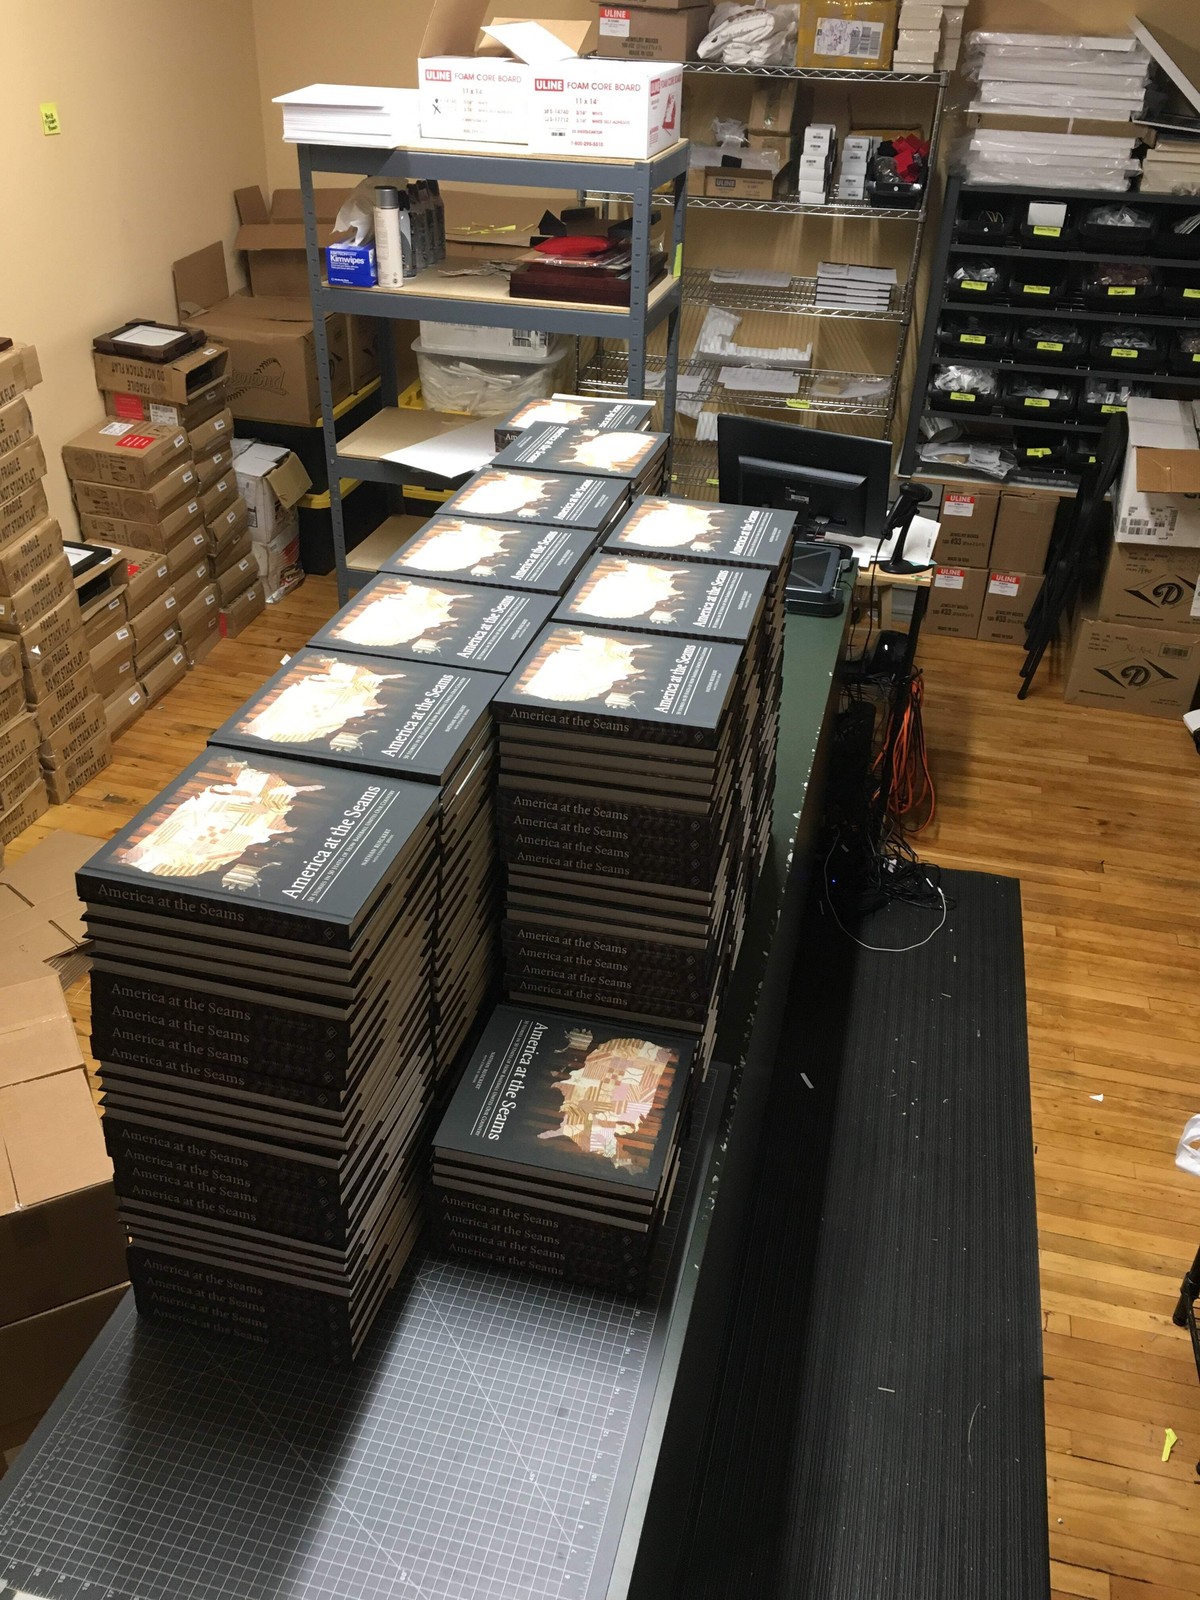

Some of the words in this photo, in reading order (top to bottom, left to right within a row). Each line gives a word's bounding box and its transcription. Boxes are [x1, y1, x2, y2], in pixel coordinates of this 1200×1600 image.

[604, 9, 626, 18] ULINE
[426, 70, 451, 81] ULINE
[498, 75, 522, 83] BOARD
[536, 80, 563, 90] ULINE
[567, 82, 589, 90] FOAM
[615, 84, 641, 92] BOARD
[330, 255, 364, 265] Kimwipes
[127, 380, 150, 394] FRAGILE
[20, 535, 40, 557] FRAGILE
[510, 559, 536, 580] America
[996, 574, 1016, 583] ULINE
[31, 573, 50, 597] FRAGILE
[491, 595, 515, 613] Seams
[692, 602, 714, 627] America
[711, 570, 729, 586] Seams
[483, 613, 500, 624] the
[52, 644, 70, 664] FRAGILE
[457, 631, 488, 659] America
[676, 645, 696, 664] Seams
[670, 664, 687, 675] the
[56, 680, 76, 702] FRAGILE
[425, 674, 454, 698] Seams
[654, 683, 680, 713] America
[65, 695, 81, 715] STACK
[79, 686, 89, 702] FLAT
[414, 698, 436, 712] the
[68, 712, 87, 734] FRAGILE
[412, 712, 426, 720] at
[510, 708, 556, 723] America
[559, 714, 570, 724] at
[572, 716, 590, 728] the
[593, 718, 630, 732] Seams
[62, 747, 70, 760] DO
[69, 738, 78, 754] NOT
[78, 728, 92, 748] STACK
[90, 719, 100, 736] FLAT
[381, 720, 419, 758] America
[76, 747, 94, 768] FRAGILE
[344, 786, 380, 818] Seams
[513, 795, 558, 810] America
[560, 803, 570, 812] at
[573, 804, 591, 816] the
[594, 806, 629, 821] Seams
[330, 819, 355, 836] the
[513, 815, 558, 830] America
[560, 822, 570, 832] at
[573, 823, 590, 835] the
[593, 826, 629, 840] Seams
[324, 837, 342, 850] at
[516, 834, 560, 849] America
[562, 840, 573, 850] at
[575, 842, 592, 854] the
[594, 844, 630, 859] Seams
[282, 850, 332, 899] America
[98, 884, 154, 906] America
[158, 897, 171, 908] at
[174, 898, 196, 914] the
[200, 902, 245, 922] Seams
[518, 928, 560, 944] America
[562, 937, 572, 946] at
[574, 938, 591, 948] the
[594, 940, 628, 955] Seams
[522, 964, 565, 979] America
[567, 972, 577, 980] at
[580, 973, 596, 984] the
[598, 976, 632, 990] Seams
[112, 984, 165, 1004] America
[168, 996, 181, 1006] at
[184, 998, 204, 1012] the
[208, 1002, 250, 1020] Seams
[112, 1005, 165, 1026] America
[168, 1018, 180, 1029] at
[184, 1020, 204, 1034] the
[208, 1024, 250, 1044] Seams
[112, 1027, 164, 1047] America
[168, 1039, 180, 1050] at
[183, 1042, 204, 1055] the
[207, 1046, 249, 1066] Seams
[520, 1022, 548, 1065] America
[514, 1066, 526, 1078] at
[506, 1080, 524, 1098] the
[488, 1100, 516, 1140] Seams
[122, 1128, 170, 1148] America
[173, 1141, 184, 1152] at
[188, 1144, 207, 1158] the
[210, 1149, 249, 1168] Seams
[124, 1148, 173, 1169] America
[176, 1162, 188, 1172] at
[190, 1164, 209, 1178] the
[212, 1170, 250, 1188] Seams
[132, 1168, 180, 1186] America
[183, 1180, 194, 1190] at
[198, 1182, 216, 1194] the
[220, 1186, 258, 1204] Seams
[442, 1194, 487, 1212] America
[489, 1205, 500, 1216] at
[502, 1208, 520, 1220] the
[522, 1212, 560, 1229] Seams
[443, 1212, 488, 1229] America
[490, 1223, 502, 1232] at
[504, 1226, 522, 1236] the
[524, 1230, 560, 1246] Seams
[450, 1228, 494, 1246] America
[496, 1239, 508, 1248] at
[510, 1241, 528, 1252] the
[530, 1245, 566, 1261] Seams
